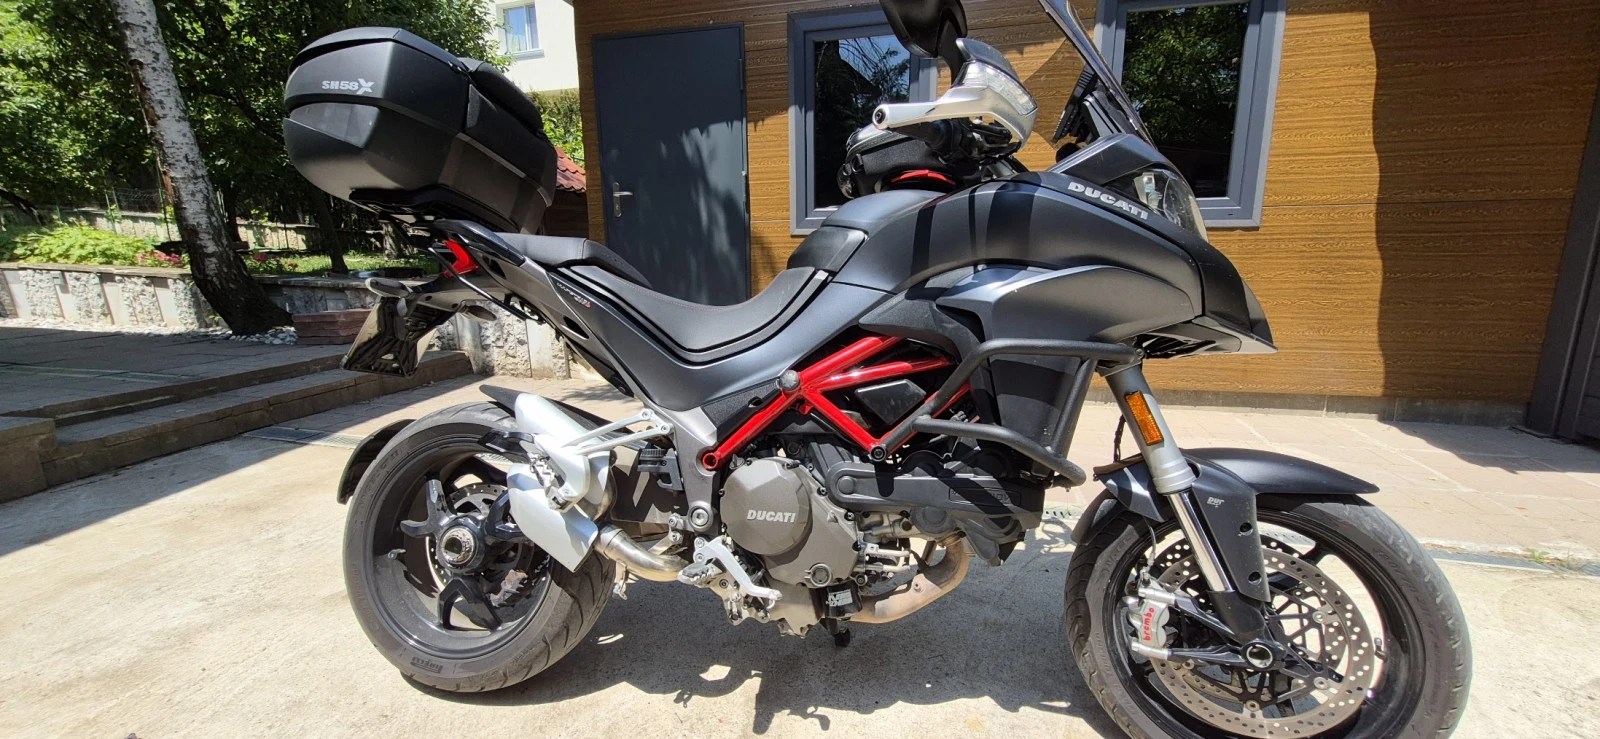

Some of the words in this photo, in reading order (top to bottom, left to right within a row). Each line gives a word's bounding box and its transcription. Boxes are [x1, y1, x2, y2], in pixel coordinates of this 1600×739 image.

[321, 78, 375, 95] SH58X
[1067, 181, 1149, 220] DUCATI
[746, 509, 796, 523] DUCATI
[1143, 607, 1155, 641] brembo
